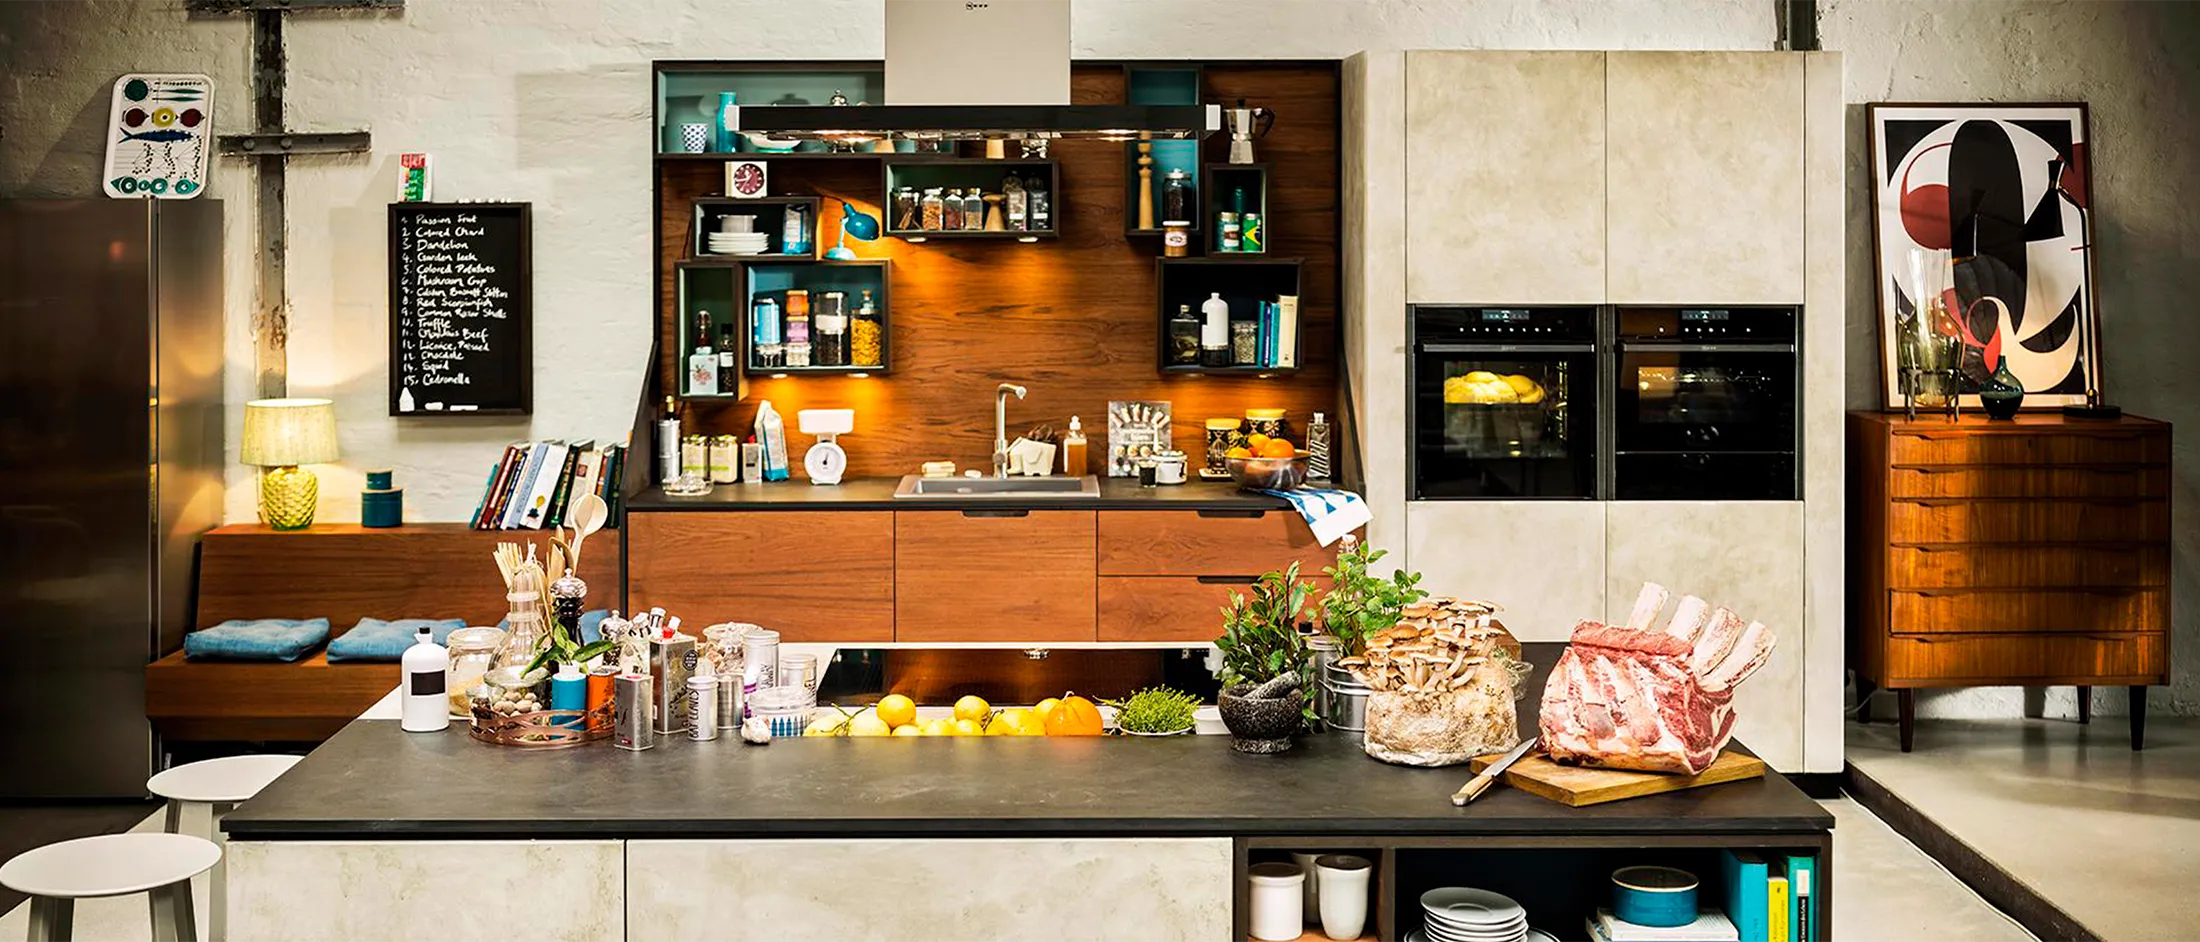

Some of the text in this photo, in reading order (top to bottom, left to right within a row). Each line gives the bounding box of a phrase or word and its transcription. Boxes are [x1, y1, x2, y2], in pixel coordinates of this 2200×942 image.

[415, 213, 451, 224] Passion
[415, 227, 451, 237] Colored
[455, 227, 485, 237] Chard
[416, 239, 469, 252] Dandelion
[416, 252, 453, 262] Garden
[416, 263, 453, 274] Colored
[416, 274, 464, 287] Mushroom
[416, 298, 437, 307] Red
[417, 318, 452, 331] Truffle
[462, 327, 489, 343] Beef
[422, 360, 450, 375] Squid
